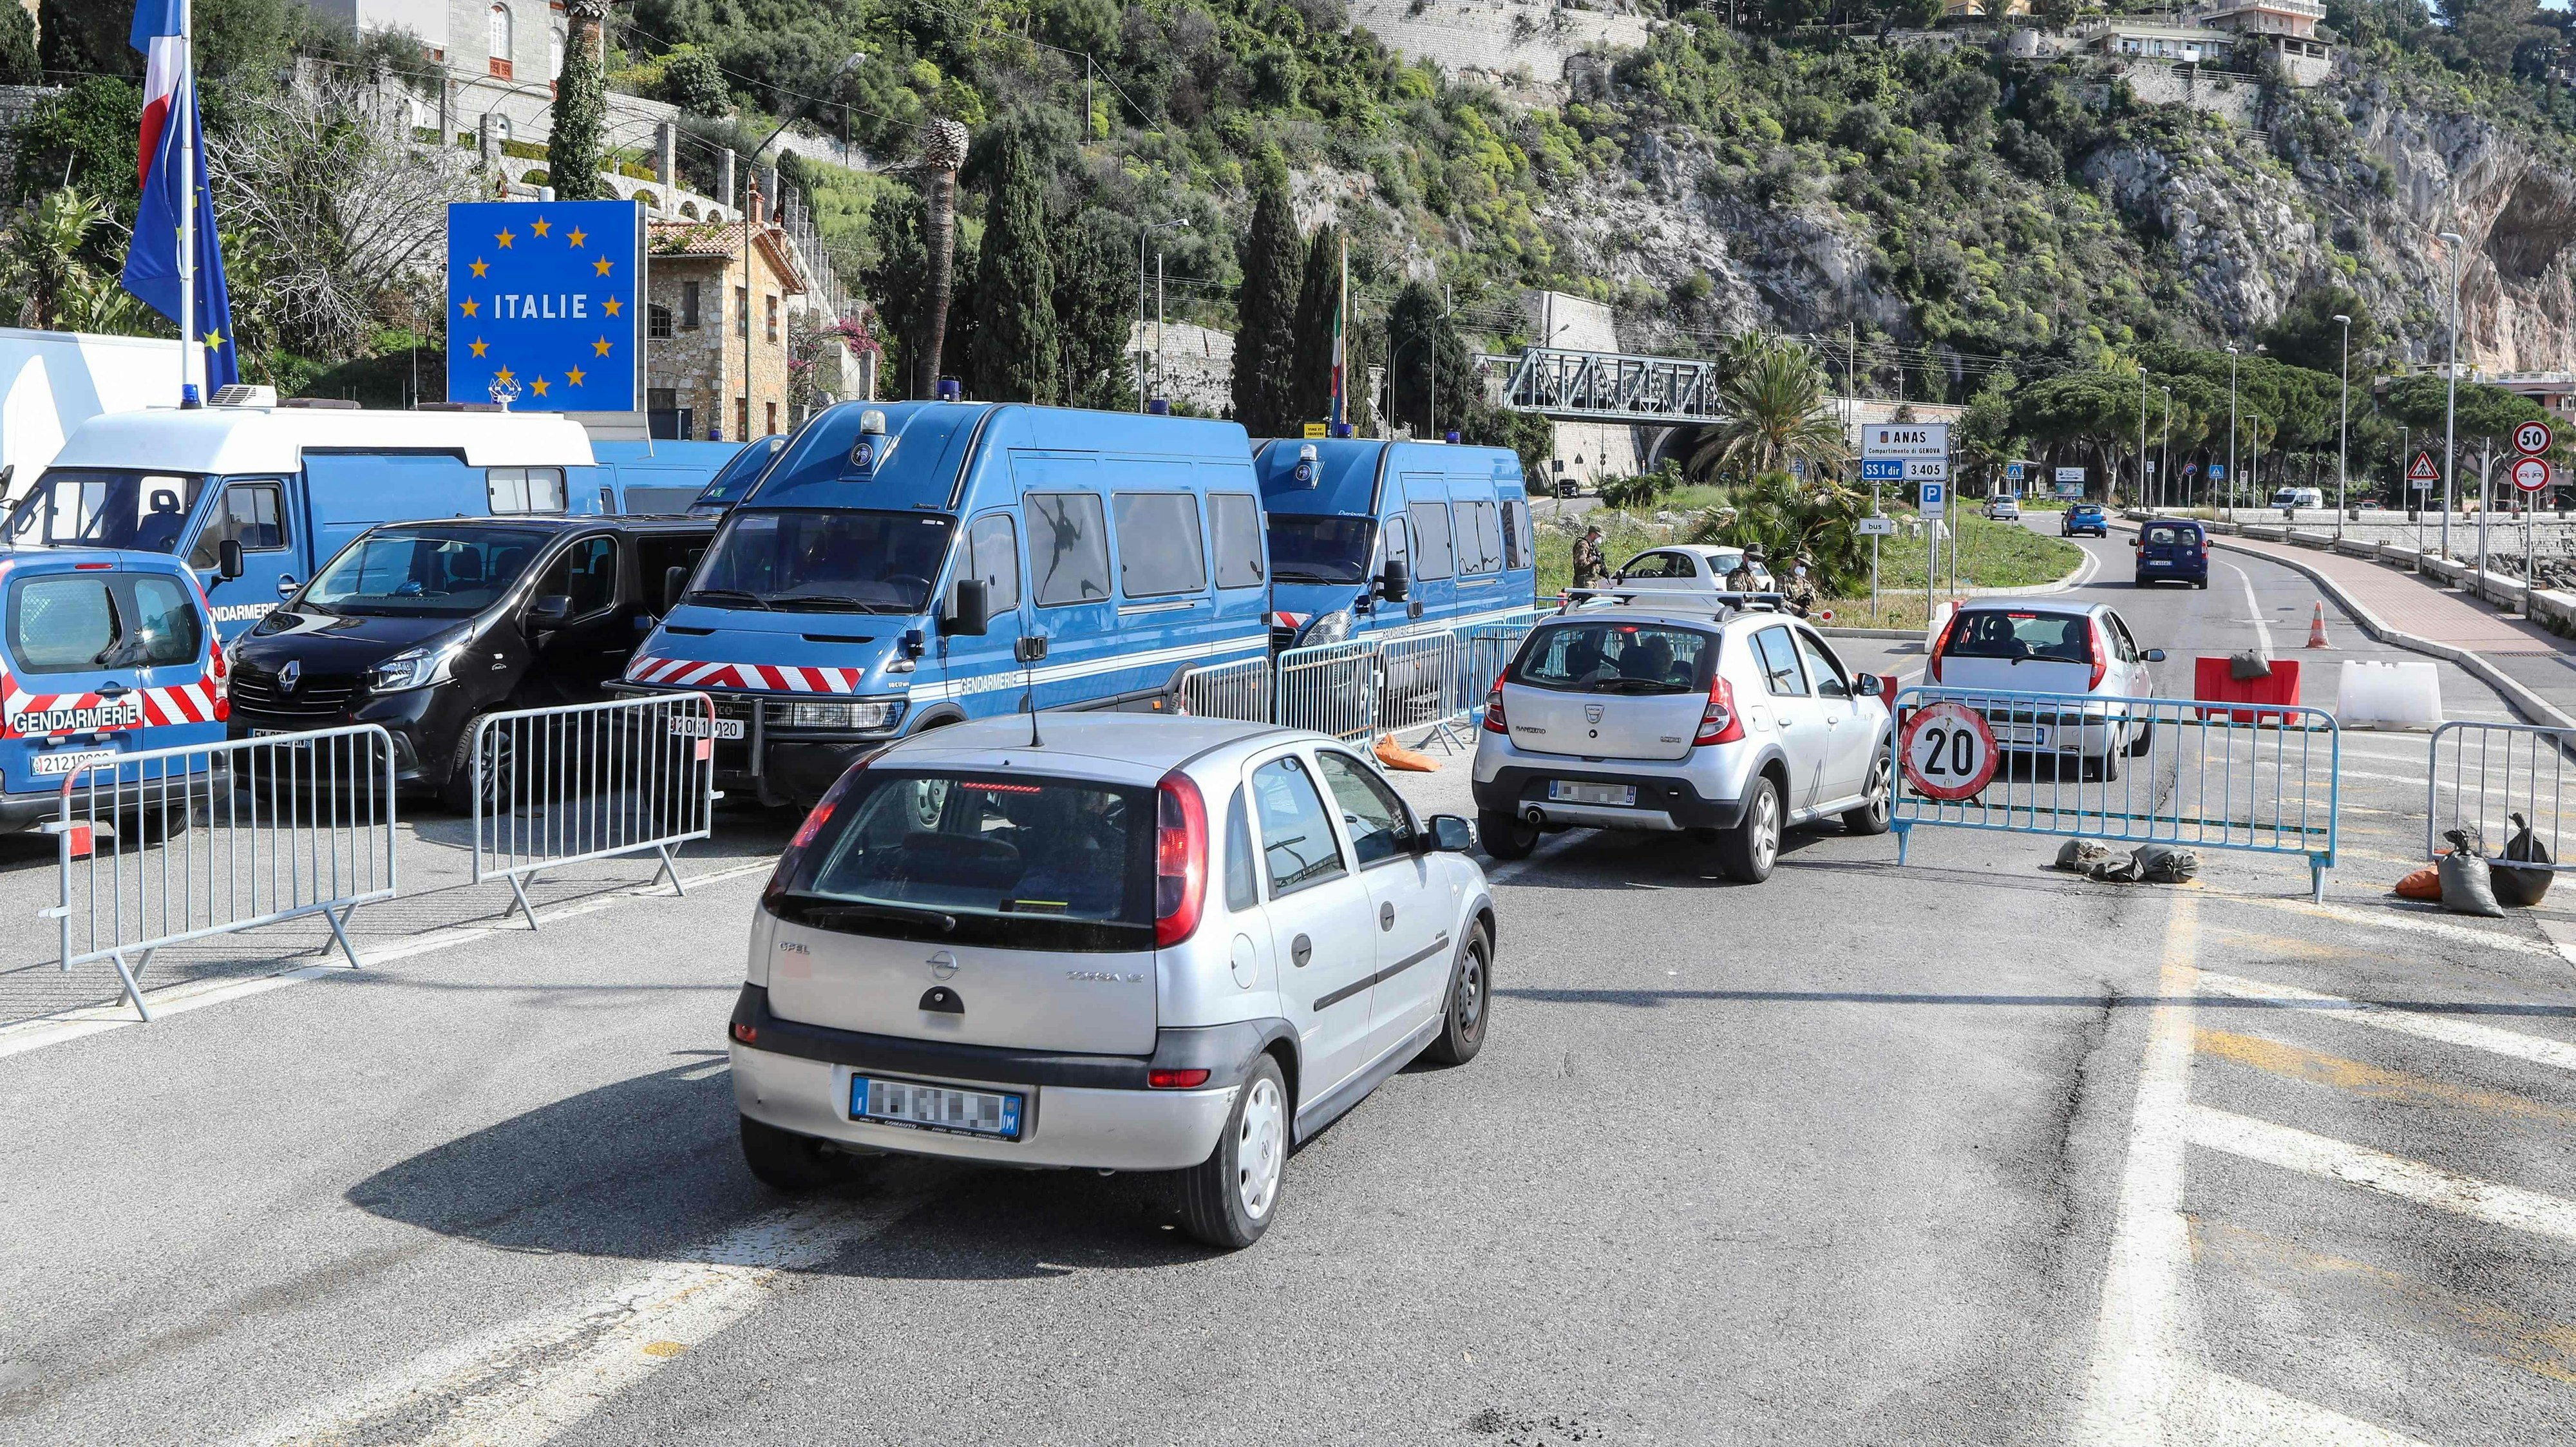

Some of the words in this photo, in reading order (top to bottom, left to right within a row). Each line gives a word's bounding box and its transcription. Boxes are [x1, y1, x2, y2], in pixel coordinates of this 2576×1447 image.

[495, 294, 587, 319] ITALIE
[1893, 431, 1926, 443] ANAS
[2521, 431, 2542, 446] 50
[1866, 464, 1879, 475] SS
[1880, 464, 1886, 475] 1
[1888, 466, 1900, 475] dir
[1911, 464, 1940, 476] 3.405
[1927, 487, 1937, 500] P
[960, 672, 1017, 695] GENDARMERIE
[13, 705, 137, 733] GENDARMERIE
[678, 719, 737, 736] 2061020
[1924, 728, 1974, 777] 20
[779, 941, 810, 954] OPEL
[857, 1097, 862, 1111] I
[1002, 1114, 1015, 1130] IM
